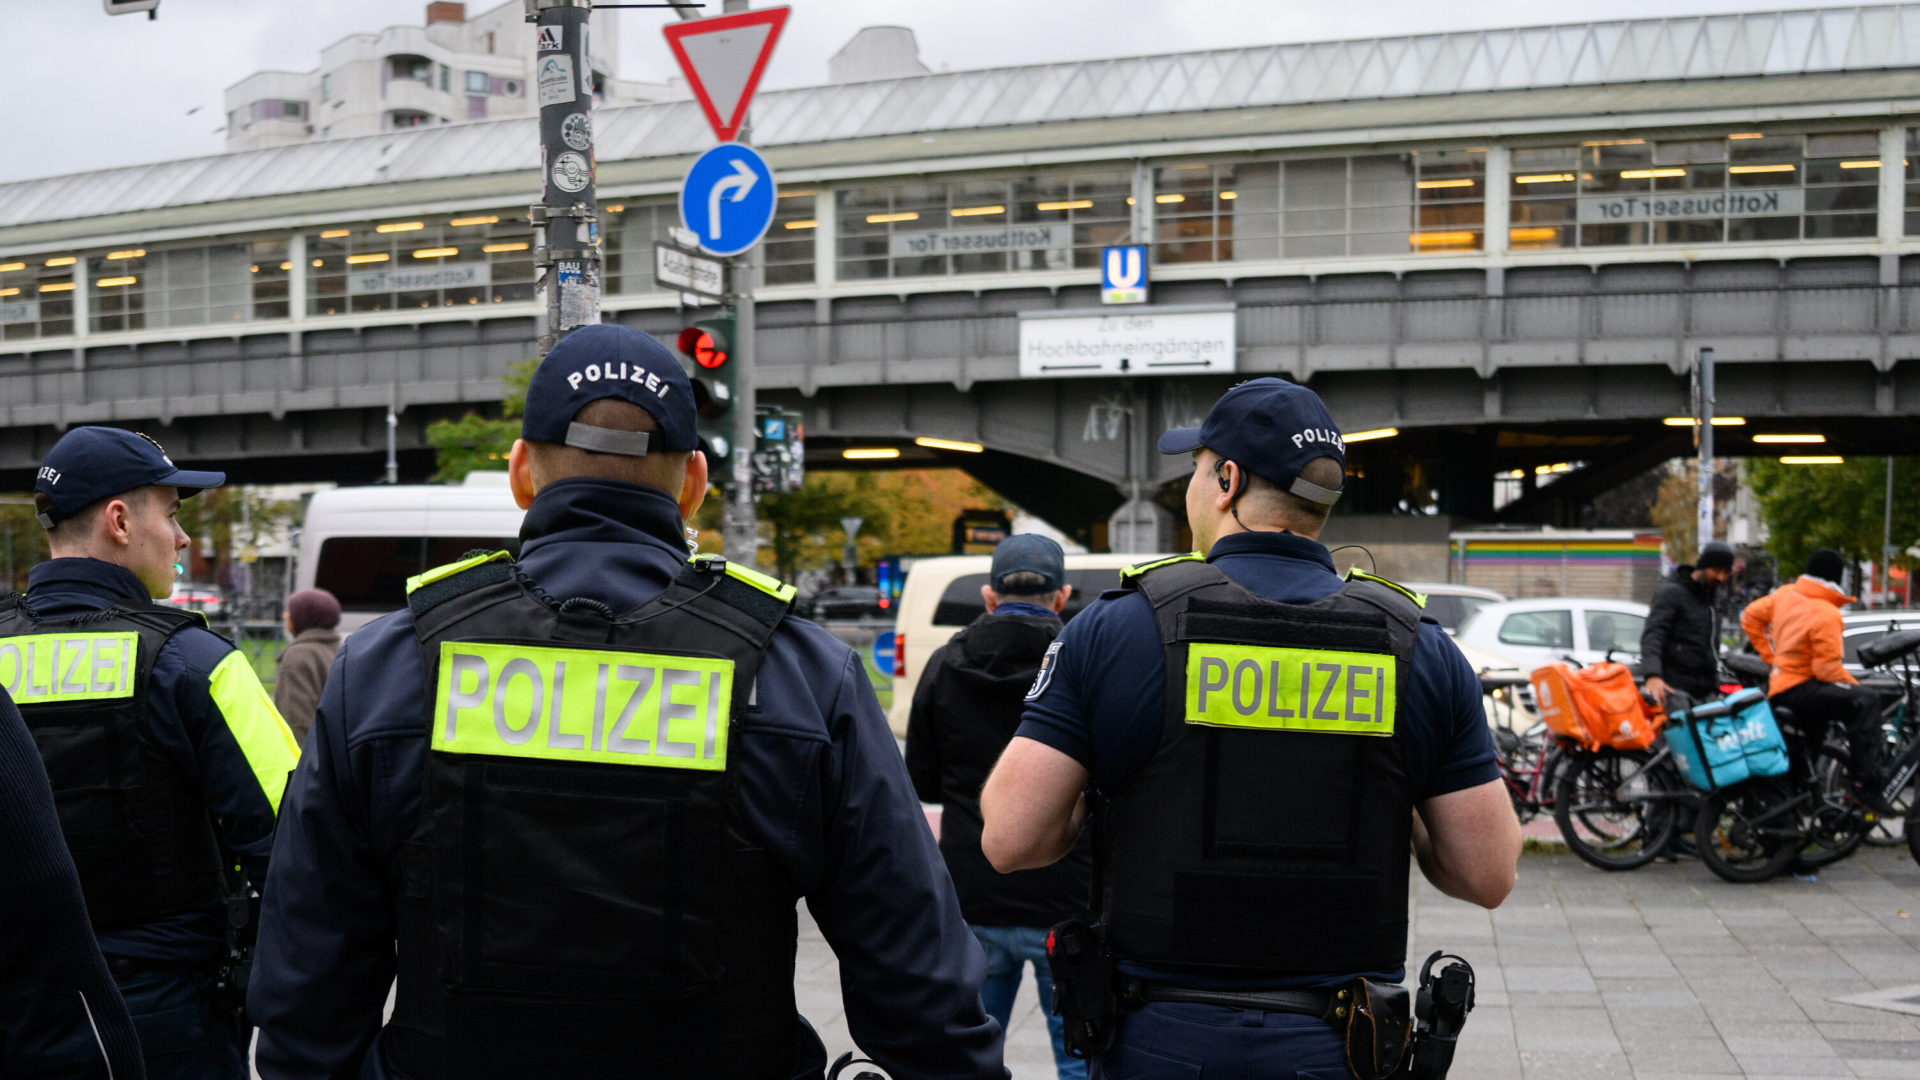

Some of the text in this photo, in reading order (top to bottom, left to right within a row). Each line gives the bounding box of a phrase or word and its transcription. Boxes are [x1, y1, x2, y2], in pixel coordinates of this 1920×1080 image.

[558, 262, 580, 271] BAU
[1108, 249, 1141, 289] U
[1099, 315, 1153, 332] Zu den
[1028, 337, 1225, 361] Hochbahneingängen
[567, 362, 670, 399] POLIZEI
[0, 638, 130, 697] OLIZEI
[444, 653, 721, 760] POLIZEI
[1197, 656, 1385, 724] POLIZEI
